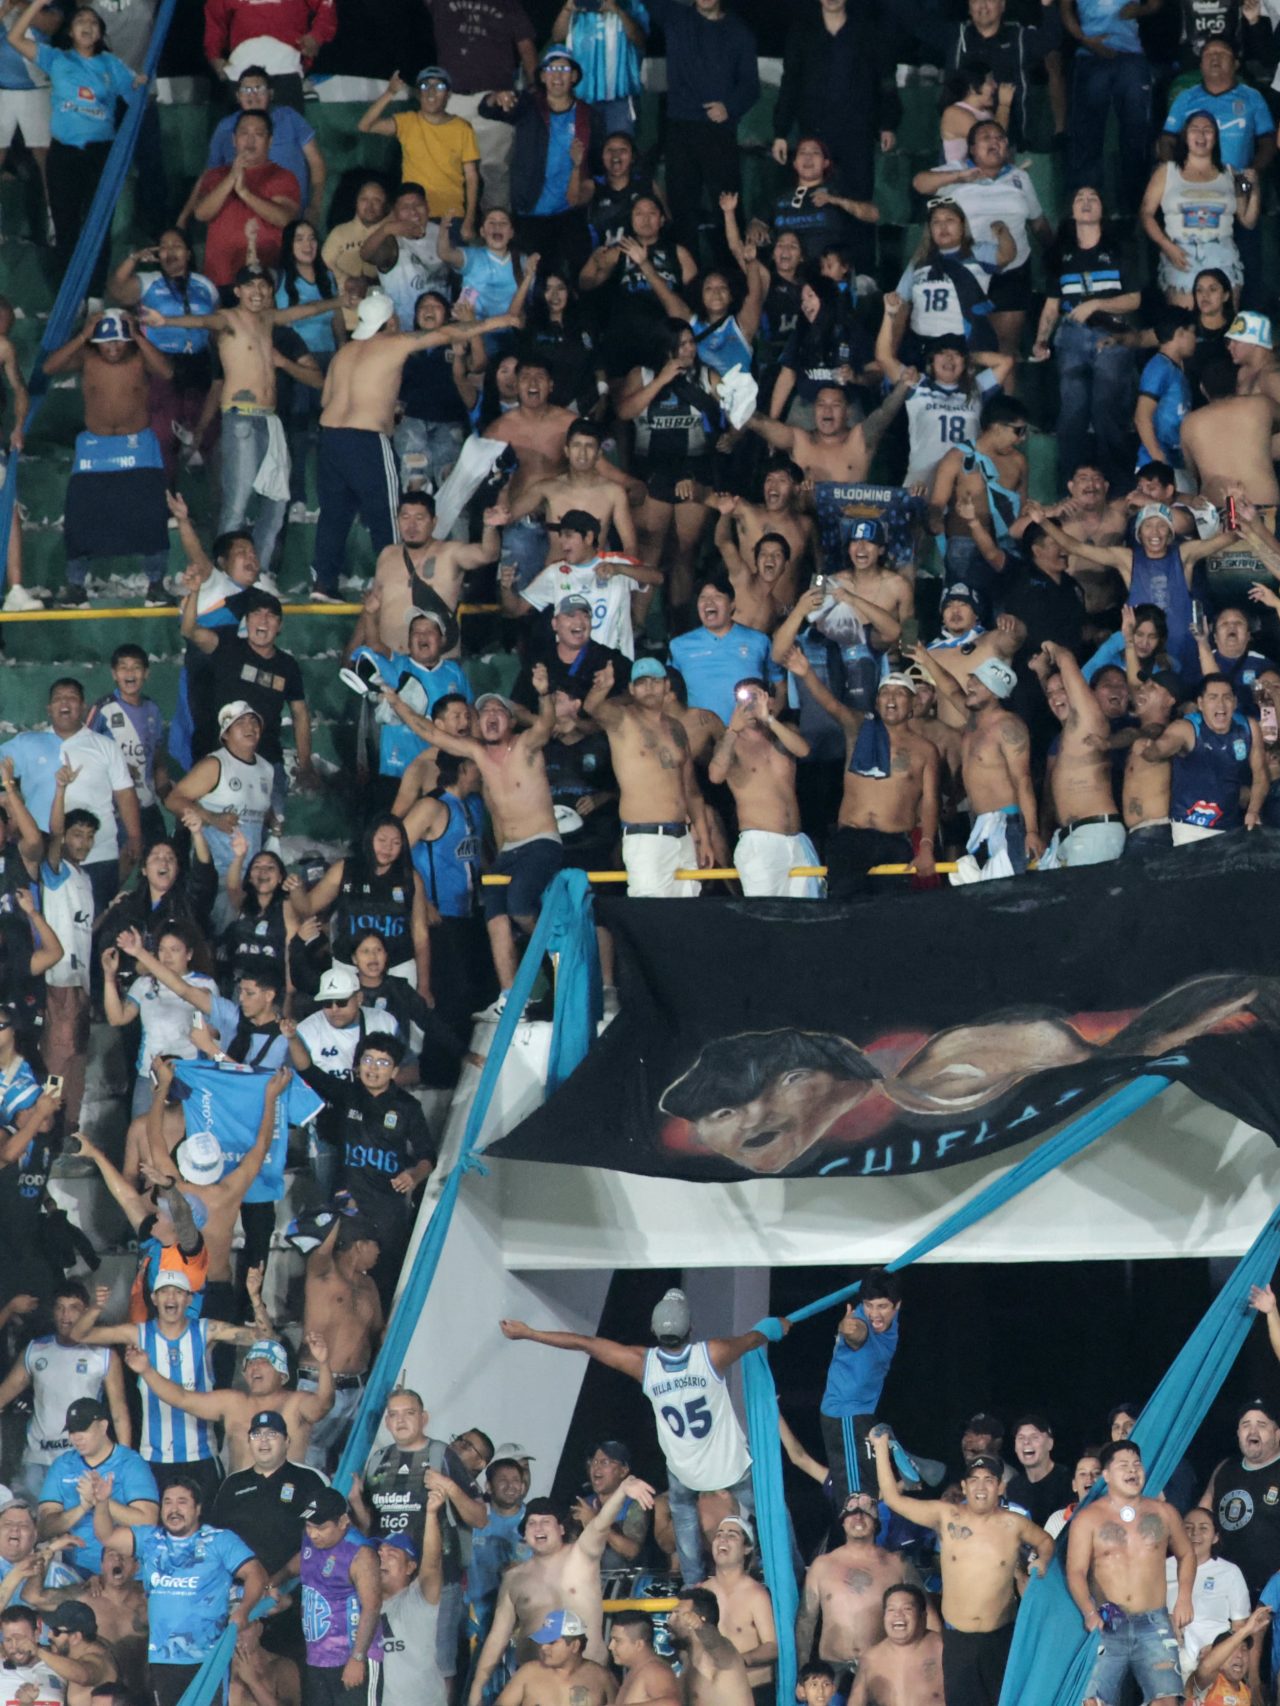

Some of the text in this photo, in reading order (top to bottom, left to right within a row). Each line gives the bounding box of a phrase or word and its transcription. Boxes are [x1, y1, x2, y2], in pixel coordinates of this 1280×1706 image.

[923, 288, 950, 313] 18
[938, 414, 967, 444] 18
[833, 487, 893, 502] BLOOMING
[348, 914, 407, 938] 1946
[345, 1142, 400, 1173] 1946
[652, 1376, 707, 1396] VILLA ROSARIO
[660, 1396, 713, 1440] 05
[372, 1491, 412, 1505] Unidad
[161, 1575, 201, 1589] GREE
